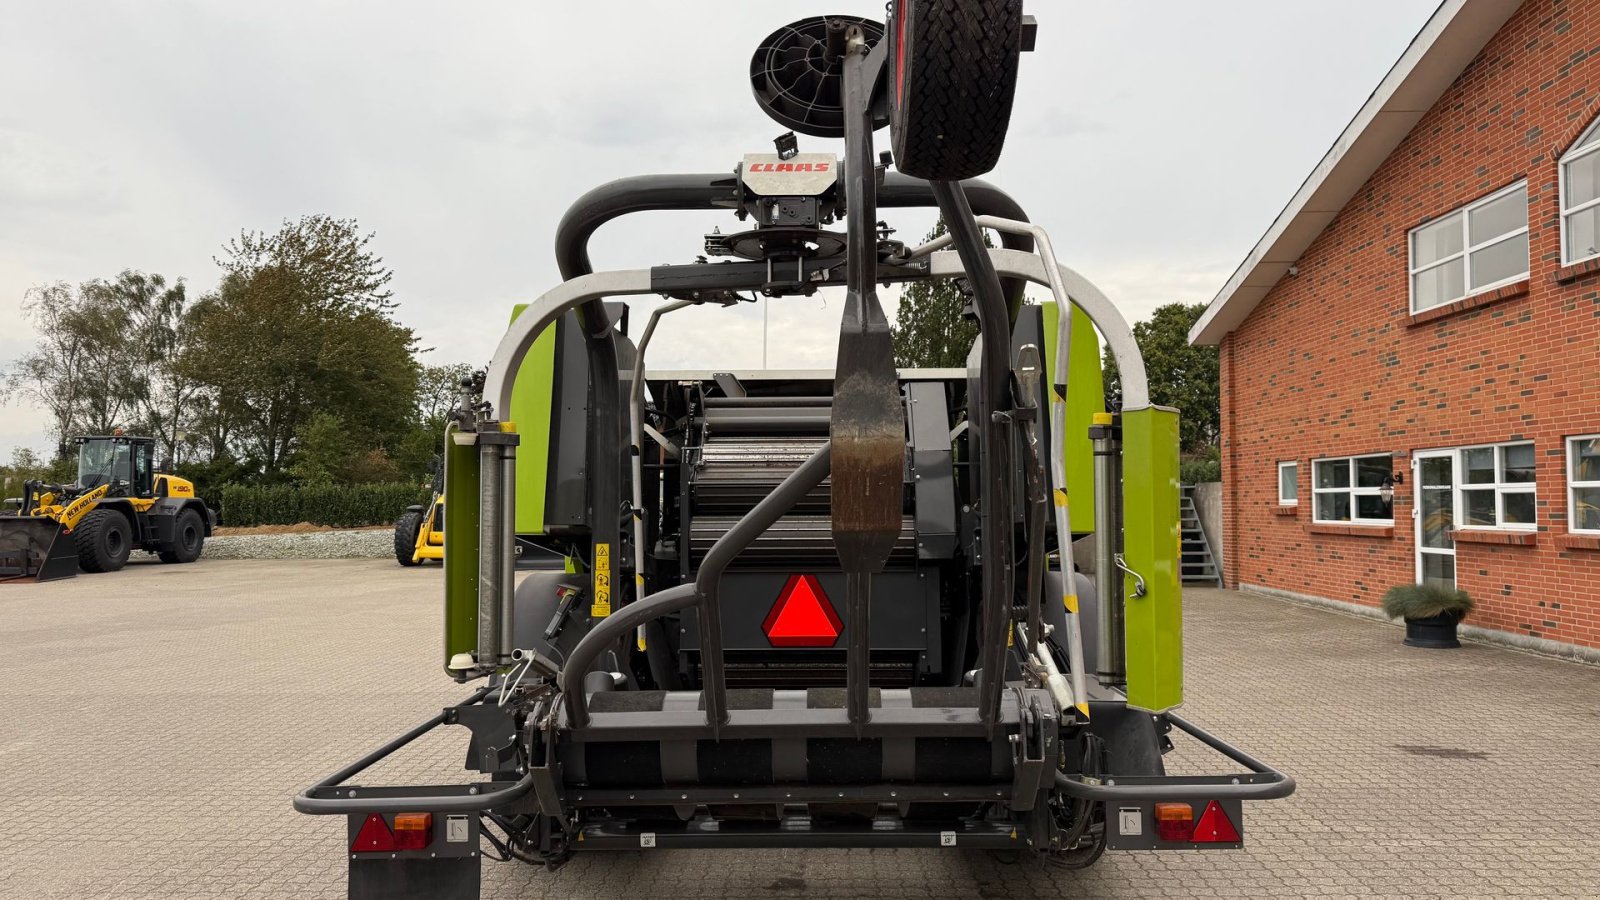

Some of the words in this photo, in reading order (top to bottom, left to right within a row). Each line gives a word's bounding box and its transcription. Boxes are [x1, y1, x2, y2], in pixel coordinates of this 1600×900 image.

[749, 163, 830, 173] CLAAS
[67, 505, 79, 518] NEW
[79, 490, 103, 509] HOLLAND
